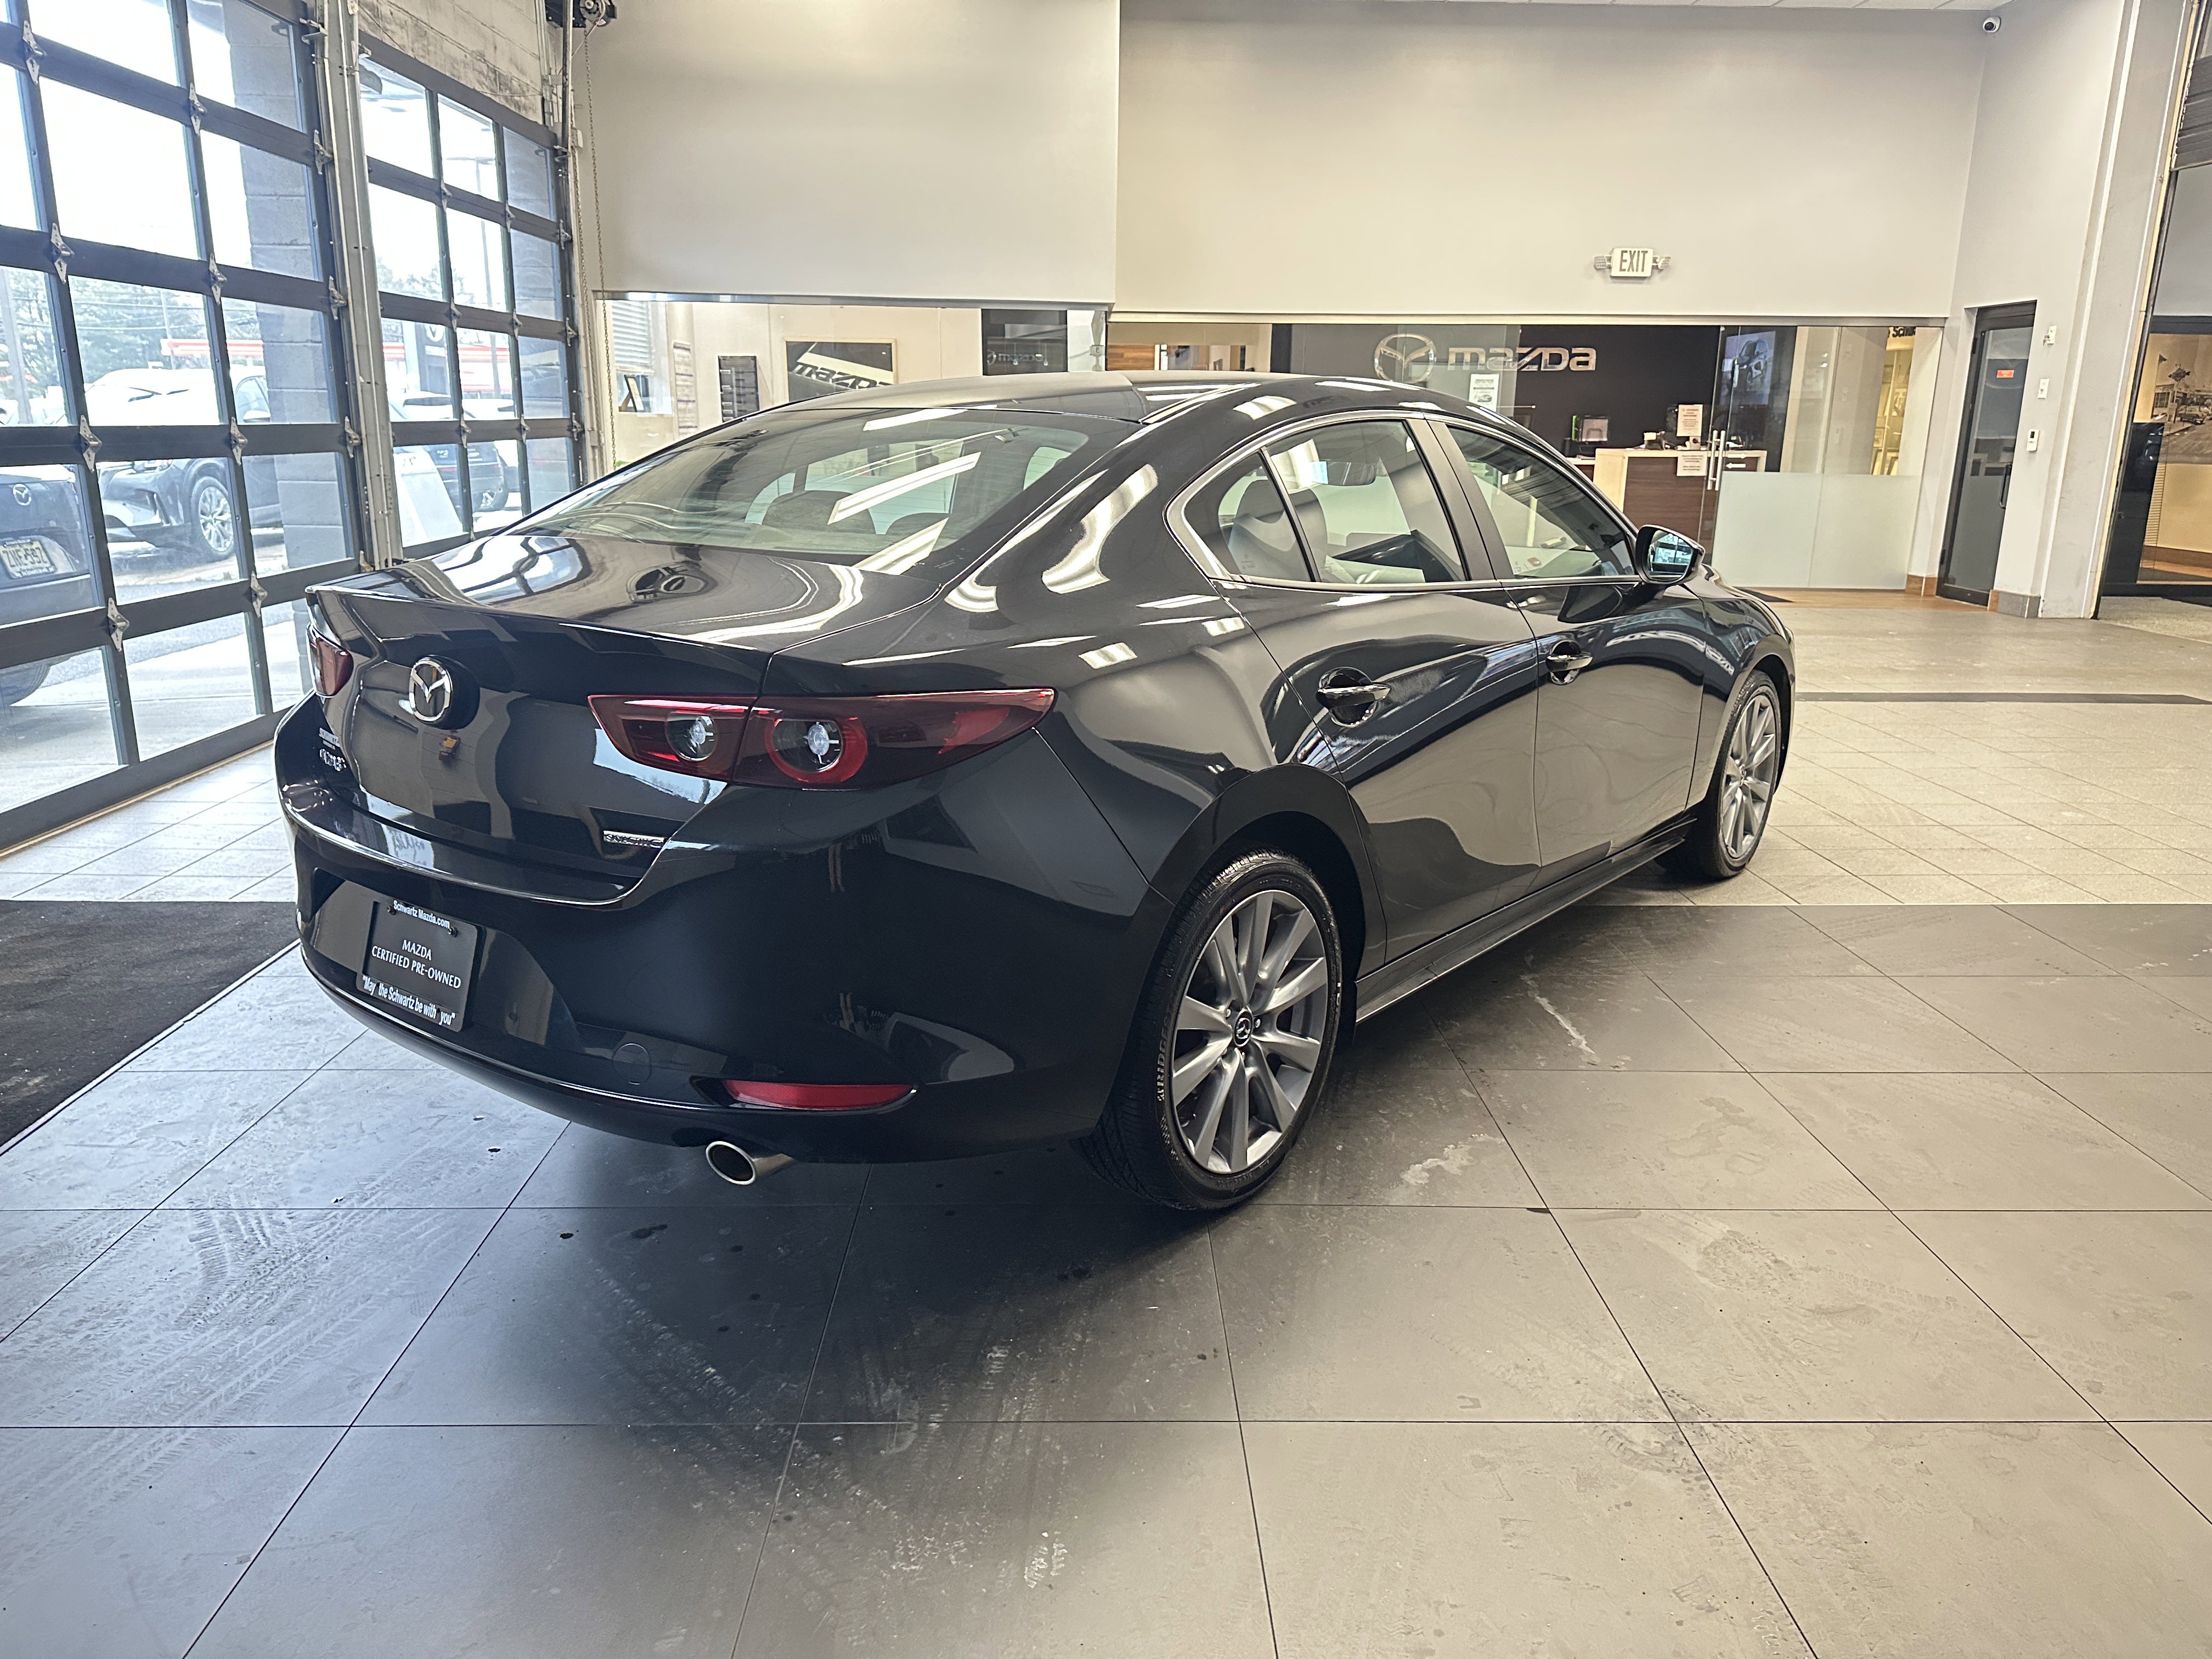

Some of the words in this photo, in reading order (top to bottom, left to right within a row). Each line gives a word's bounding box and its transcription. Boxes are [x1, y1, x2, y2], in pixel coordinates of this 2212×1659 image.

[1619, 250, 1648, 272] EXIT
[393, 900, 418, 917] Schwartz
[418, 909, 450, 929] Mazda.com
[402, 939, 432, 961] MAZDA
[371, 945, 410, 969] CERTIFIED
[411, 960, 461, 989] PRE-OWNED
[363, 975, 376, 996] "May
[378, 983, 388, 998] the
[388, 986, 414, 1009] Schwartz
[414, 997, 423, 1013] be
[423, 1003, 437, 1019] with
[439, 1011, 456, 1025] you"
